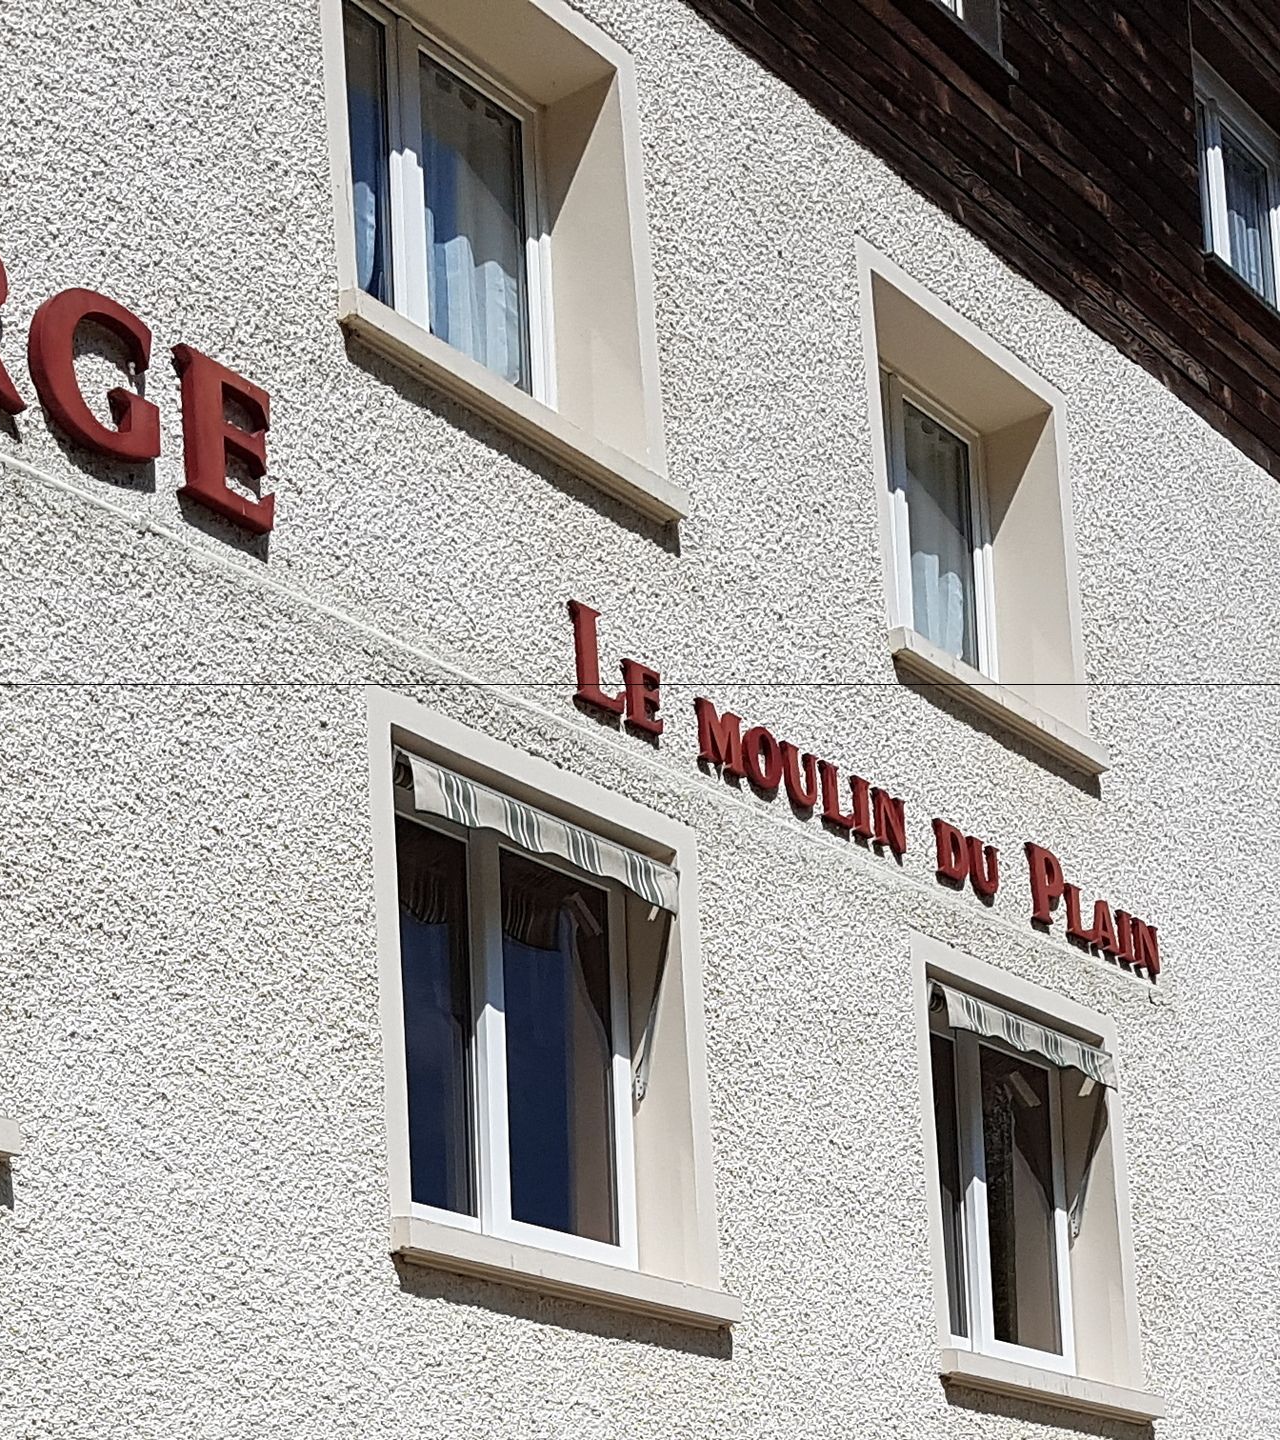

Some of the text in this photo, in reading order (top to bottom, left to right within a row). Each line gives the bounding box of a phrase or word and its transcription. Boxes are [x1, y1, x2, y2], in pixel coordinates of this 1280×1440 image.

[567, 600, 1160, 976] LE MOULIN DU PLAIN
